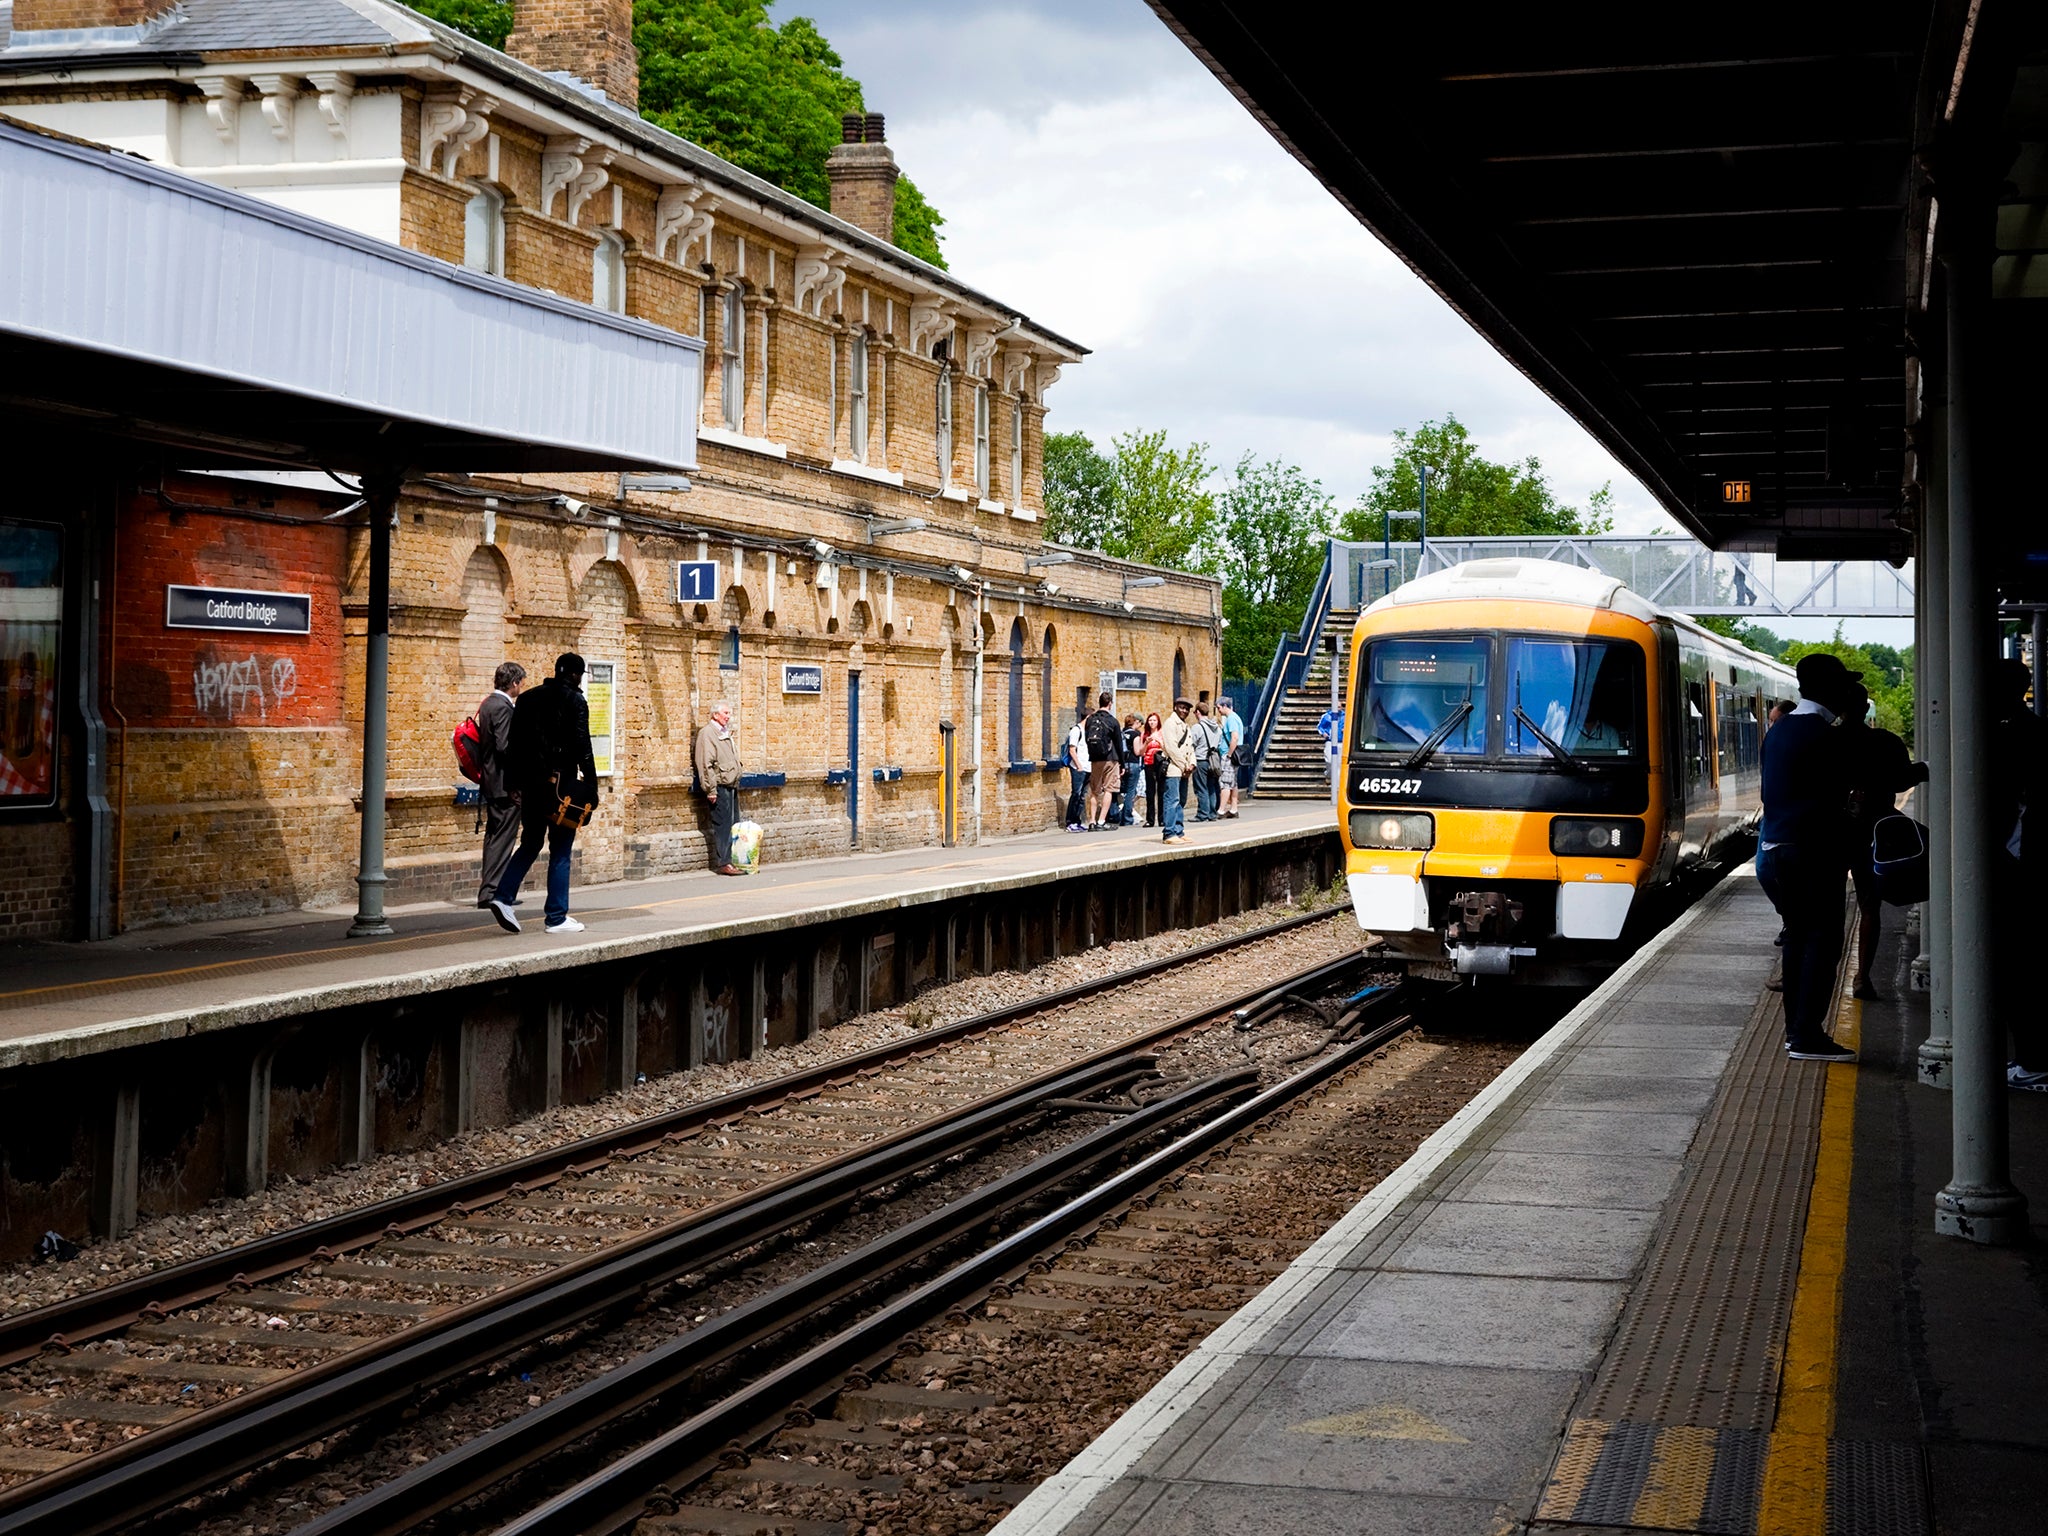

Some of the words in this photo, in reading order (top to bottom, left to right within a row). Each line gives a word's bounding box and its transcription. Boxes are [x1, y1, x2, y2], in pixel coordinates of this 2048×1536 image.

[1723, 482, 1750, 501] OFF
[688, 567, 700, 596] 1
[206, 599, 245, 620] Catford
[246, 602, 277, 625] Bridge
[787, 672, 805, 686] Catford
[1359, 777, 1422, 794] 465247
